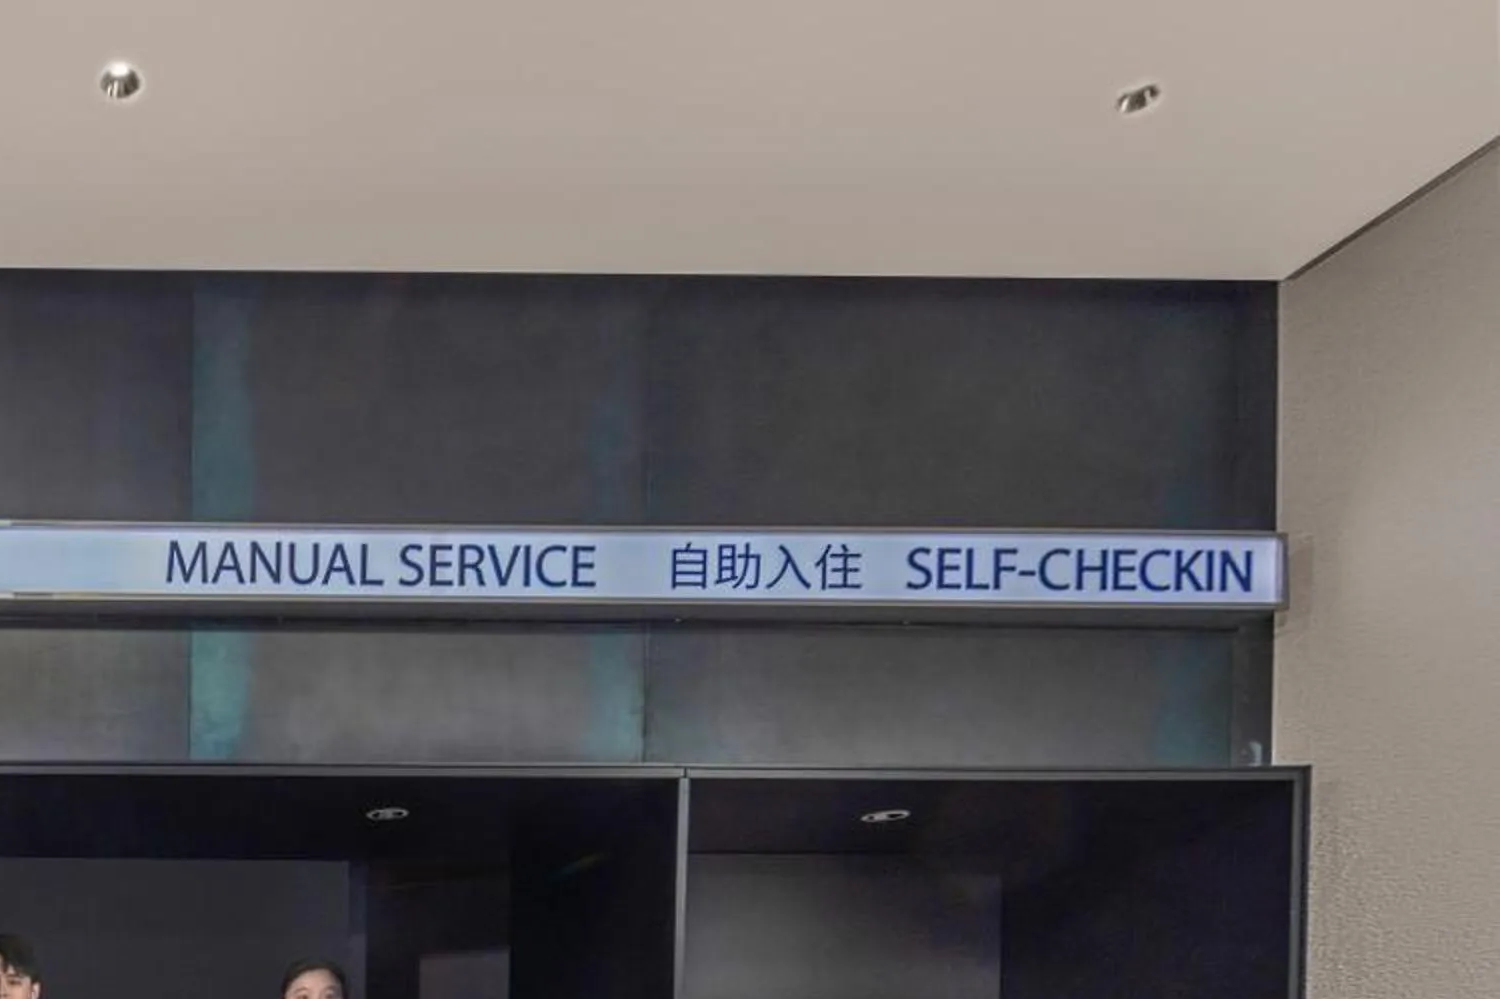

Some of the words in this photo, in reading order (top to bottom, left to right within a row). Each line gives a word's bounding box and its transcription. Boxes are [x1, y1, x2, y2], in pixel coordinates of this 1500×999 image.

[165, 540, 384, 586] MANUAL
[398, 543, 597, 588] SERVICE
[670, 542, 863, 590] 自助入住
[905, 547, 1253, 592] SELF-CHECKIN
